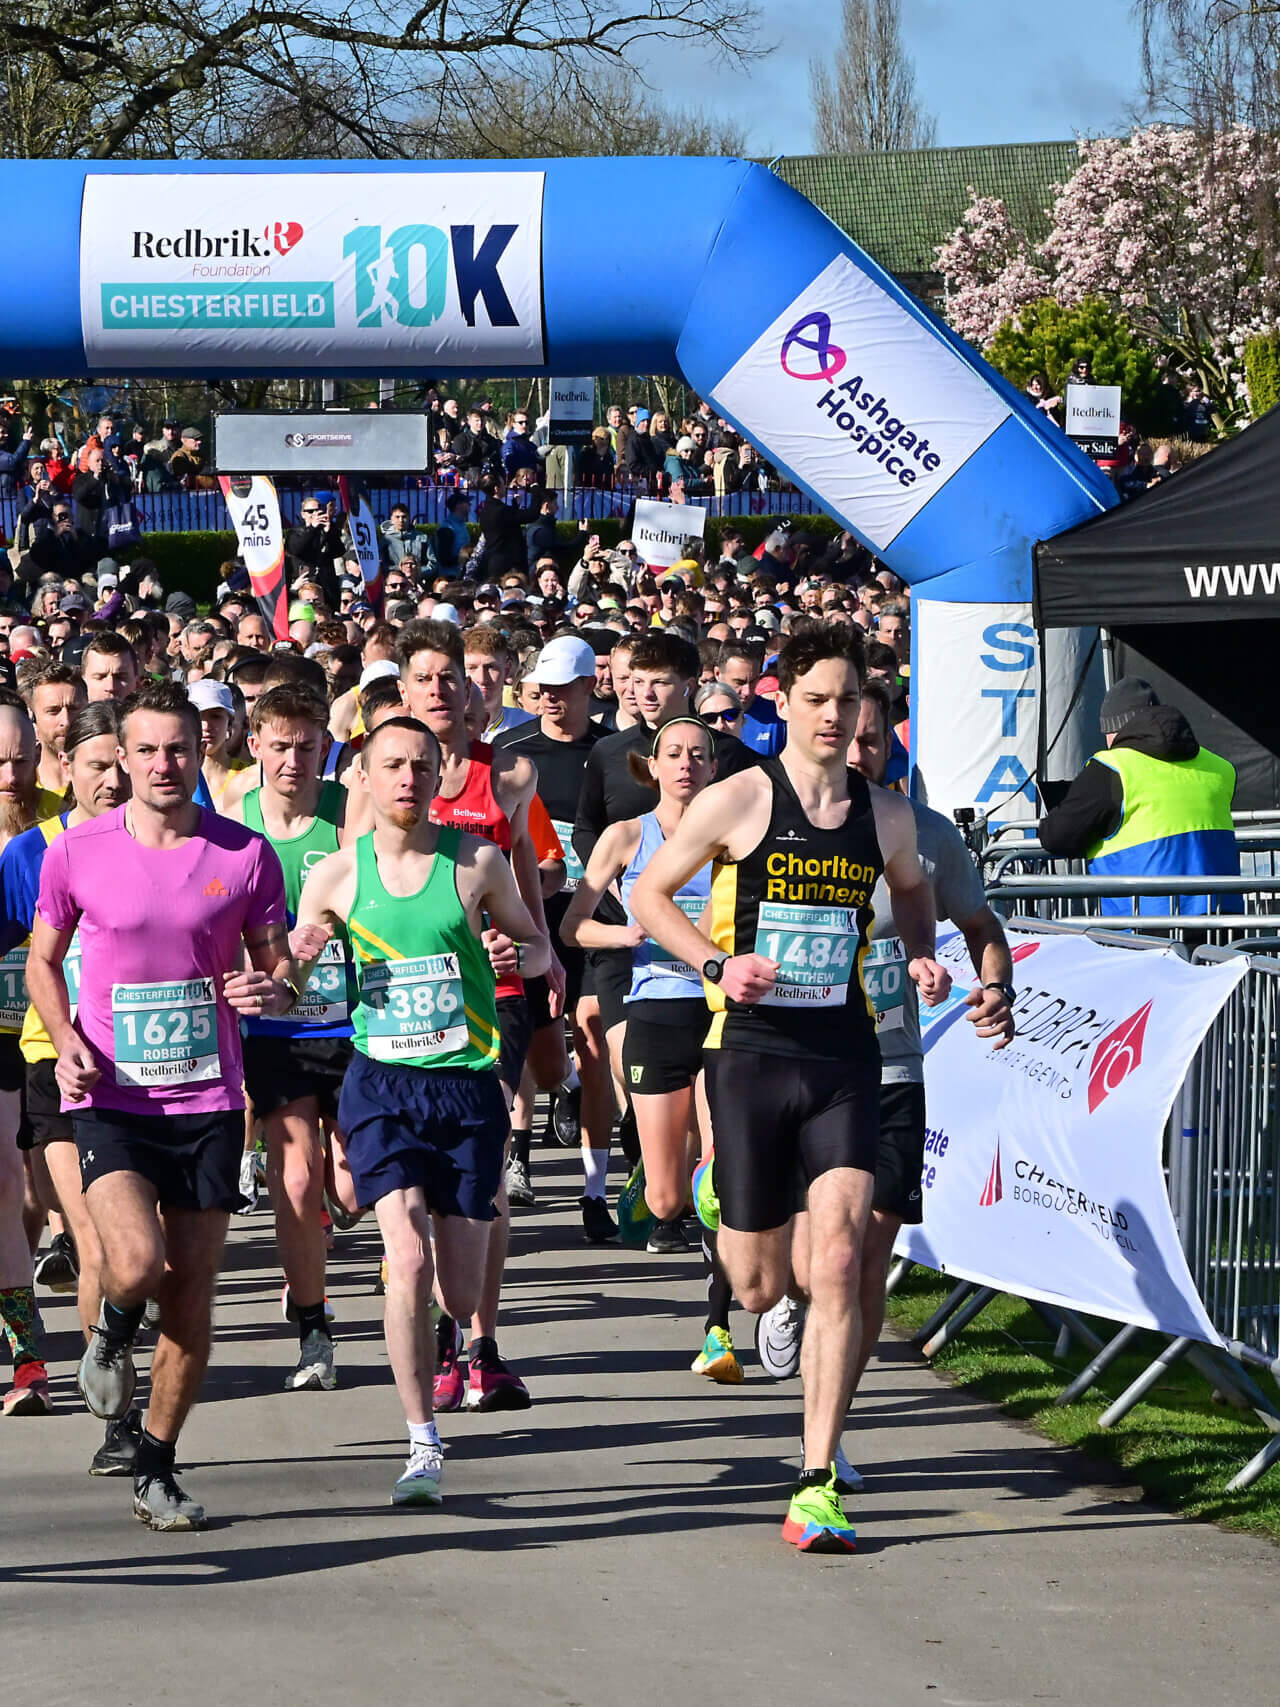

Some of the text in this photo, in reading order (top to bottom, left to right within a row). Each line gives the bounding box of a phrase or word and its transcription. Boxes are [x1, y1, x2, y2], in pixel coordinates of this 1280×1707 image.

[131, 228, 271, 259] Redbrik.
[192, 262, 271, 278] Foundation
[342, 223, 520, 329] 10K
[109, 294, 326, 319] CHESTERFIELD
[838, 375, 941, 472] Ashgate
[1072, 407, 1115, 418] Redbrik.
[816, 388, 917, 487] Hospice
[1076, 442, 1114, 454] or Sale
[241, 504, 269, 531] 45
[242, 532, 272, 548] mins
[453, 808, 487, 819] Bellway
[766, 852, 876, 883] Chorlton
[767, 878, 868, 906] Runners
[764, 909, 854, 928] CHESTERFIELD 10K
[766, 932, 850, 969] 1484
[367, 956, 455, 980] CHESTERFIELD 10K
[775, 971, 835, 984] MATTHEW
[117, 980, 212, 1001] CHESTERFIELD 10K
[864, 966, 901, 997] 40
[4, 999, 31, 1009] JAM
[370, 983, 458, 1021] 1386
[122, 1007, 211, 1046] 1625
[399, 1020, 433, 1033] RYAN
[143, 1045, 193, 1060] ROBERT
[1013, 1185, 1083, 1217] BOROUG
